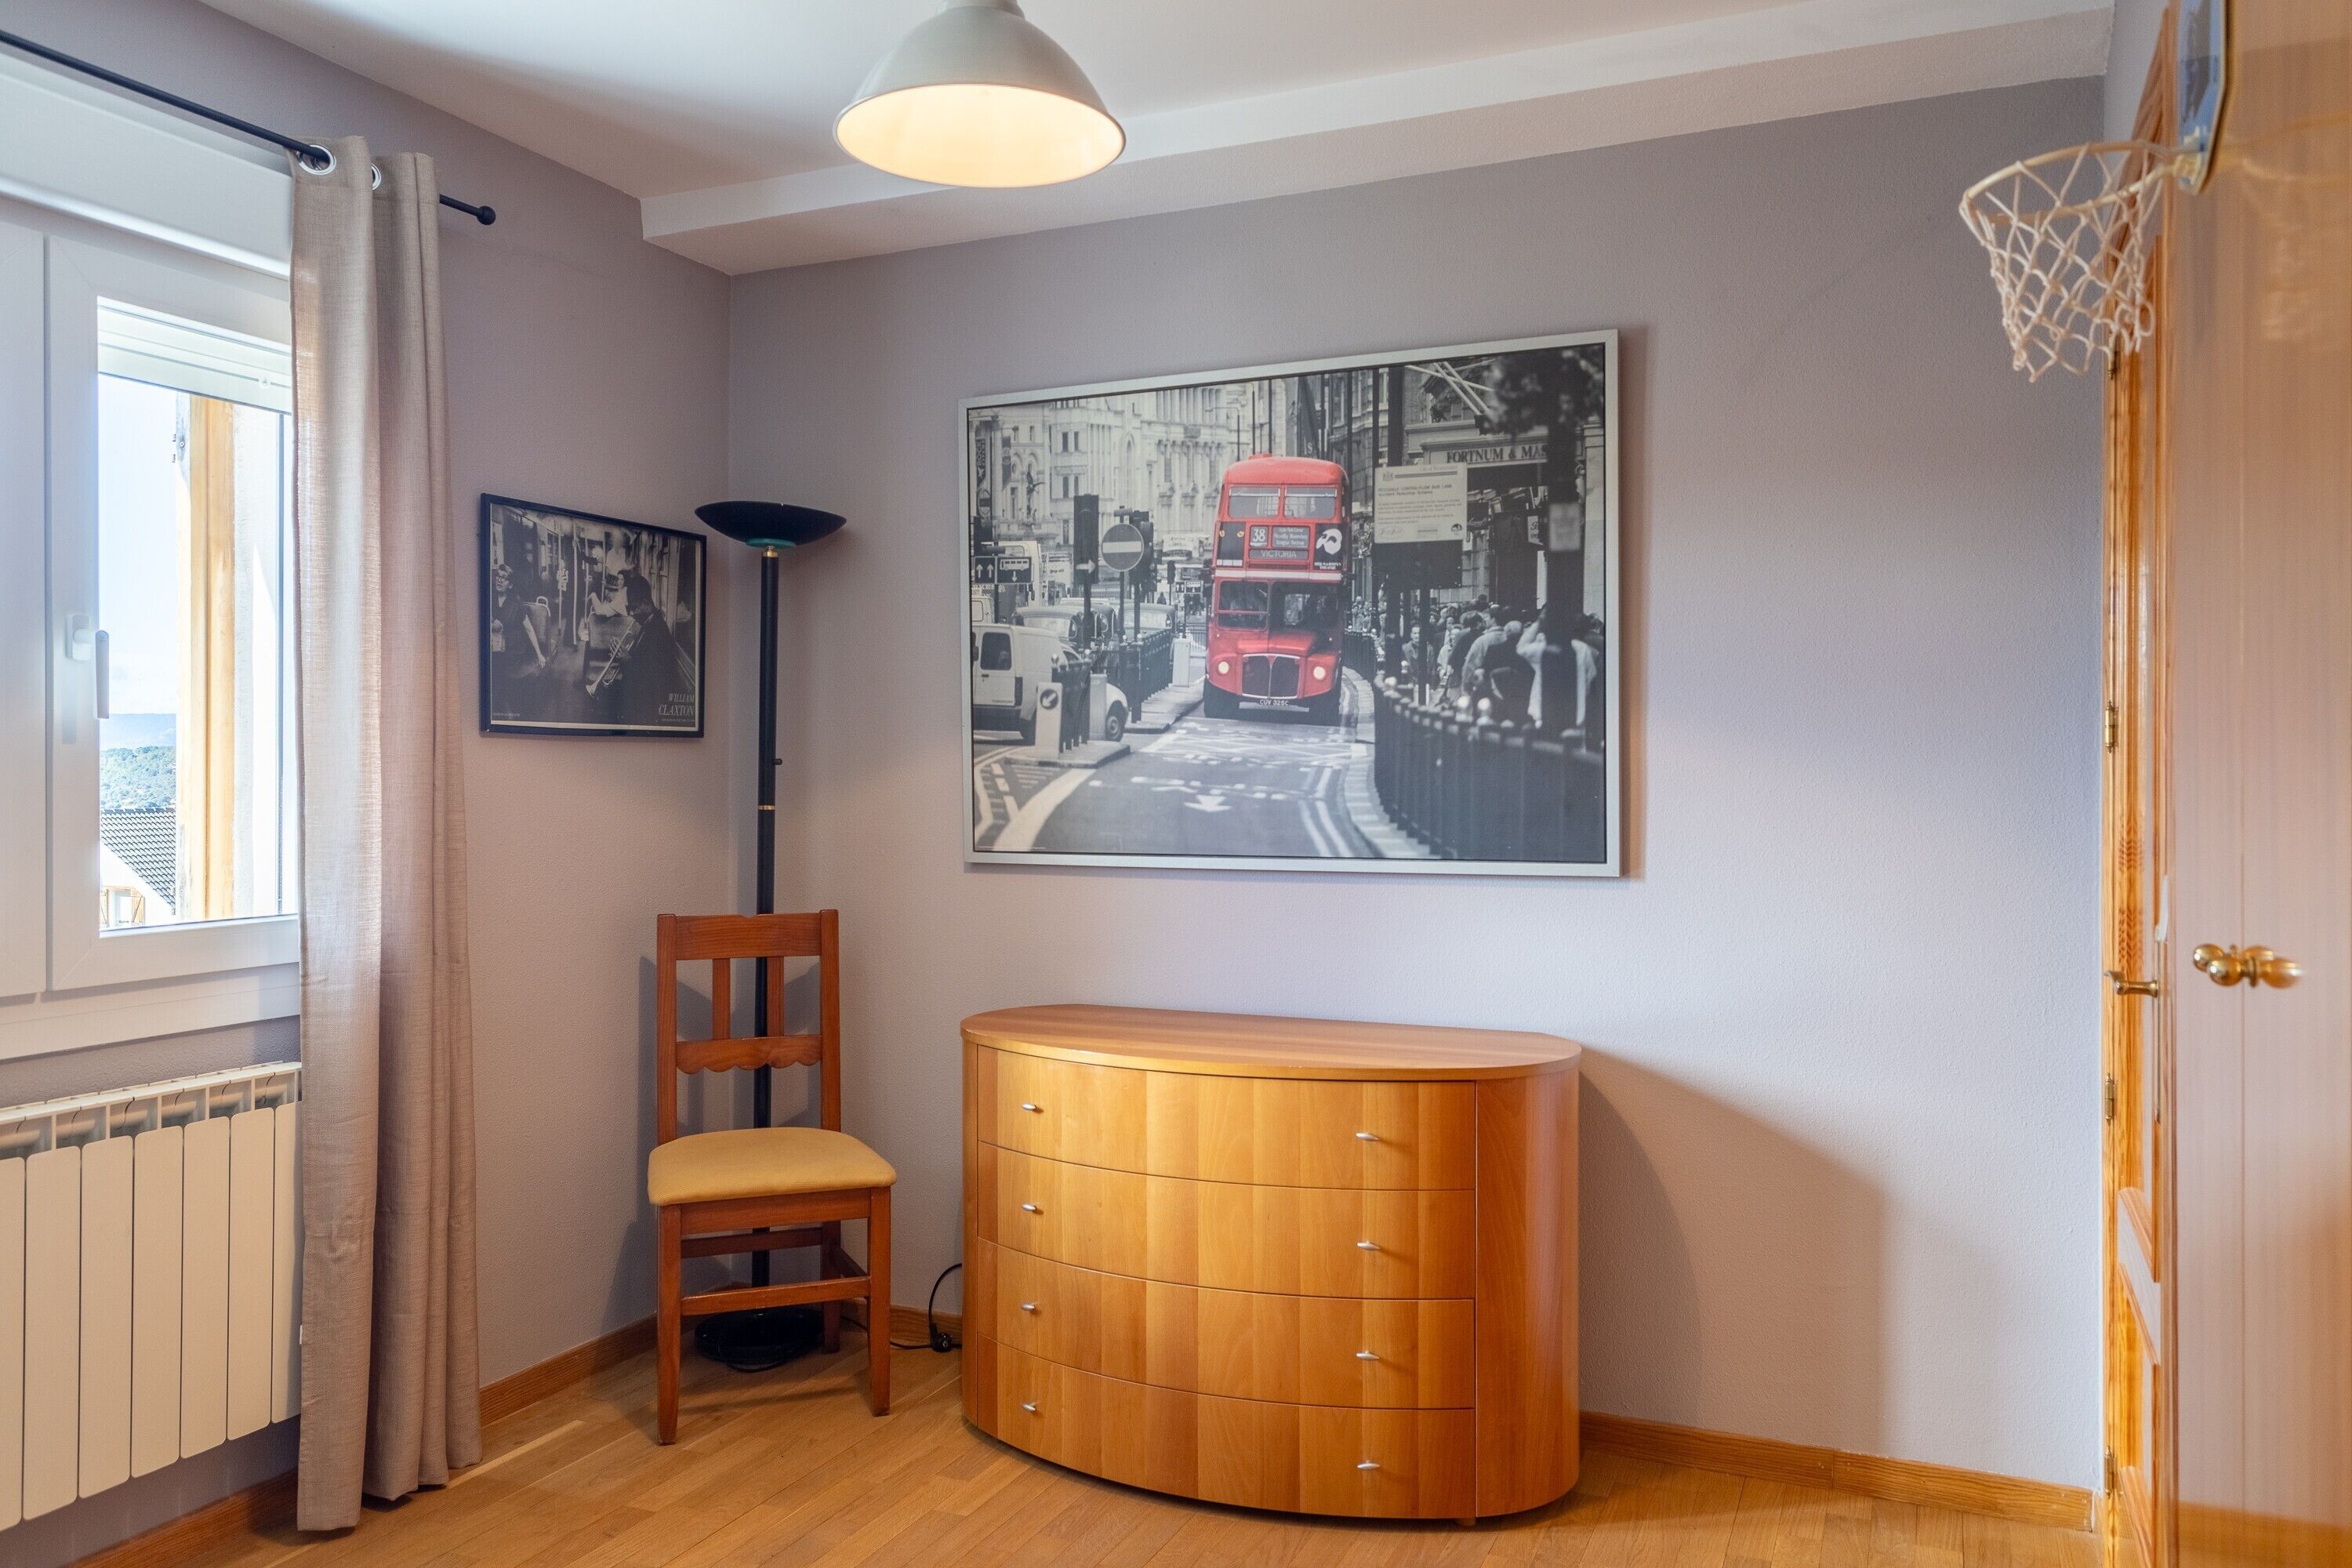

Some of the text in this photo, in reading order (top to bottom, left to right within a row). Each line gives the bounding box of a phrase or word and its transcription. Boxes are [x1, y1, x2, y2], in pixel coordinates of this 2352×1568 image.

[1446, 448, 1504, 463] FORTNUM
[1508, 446, 1517, 459] &
[1253, 528, 1266, 543] 38
[1261, 550, 1297, 558] VICTORIA
[669, 693, 696, 703] WILLIAM
[658, 704, 696, 717] CLAXTON
